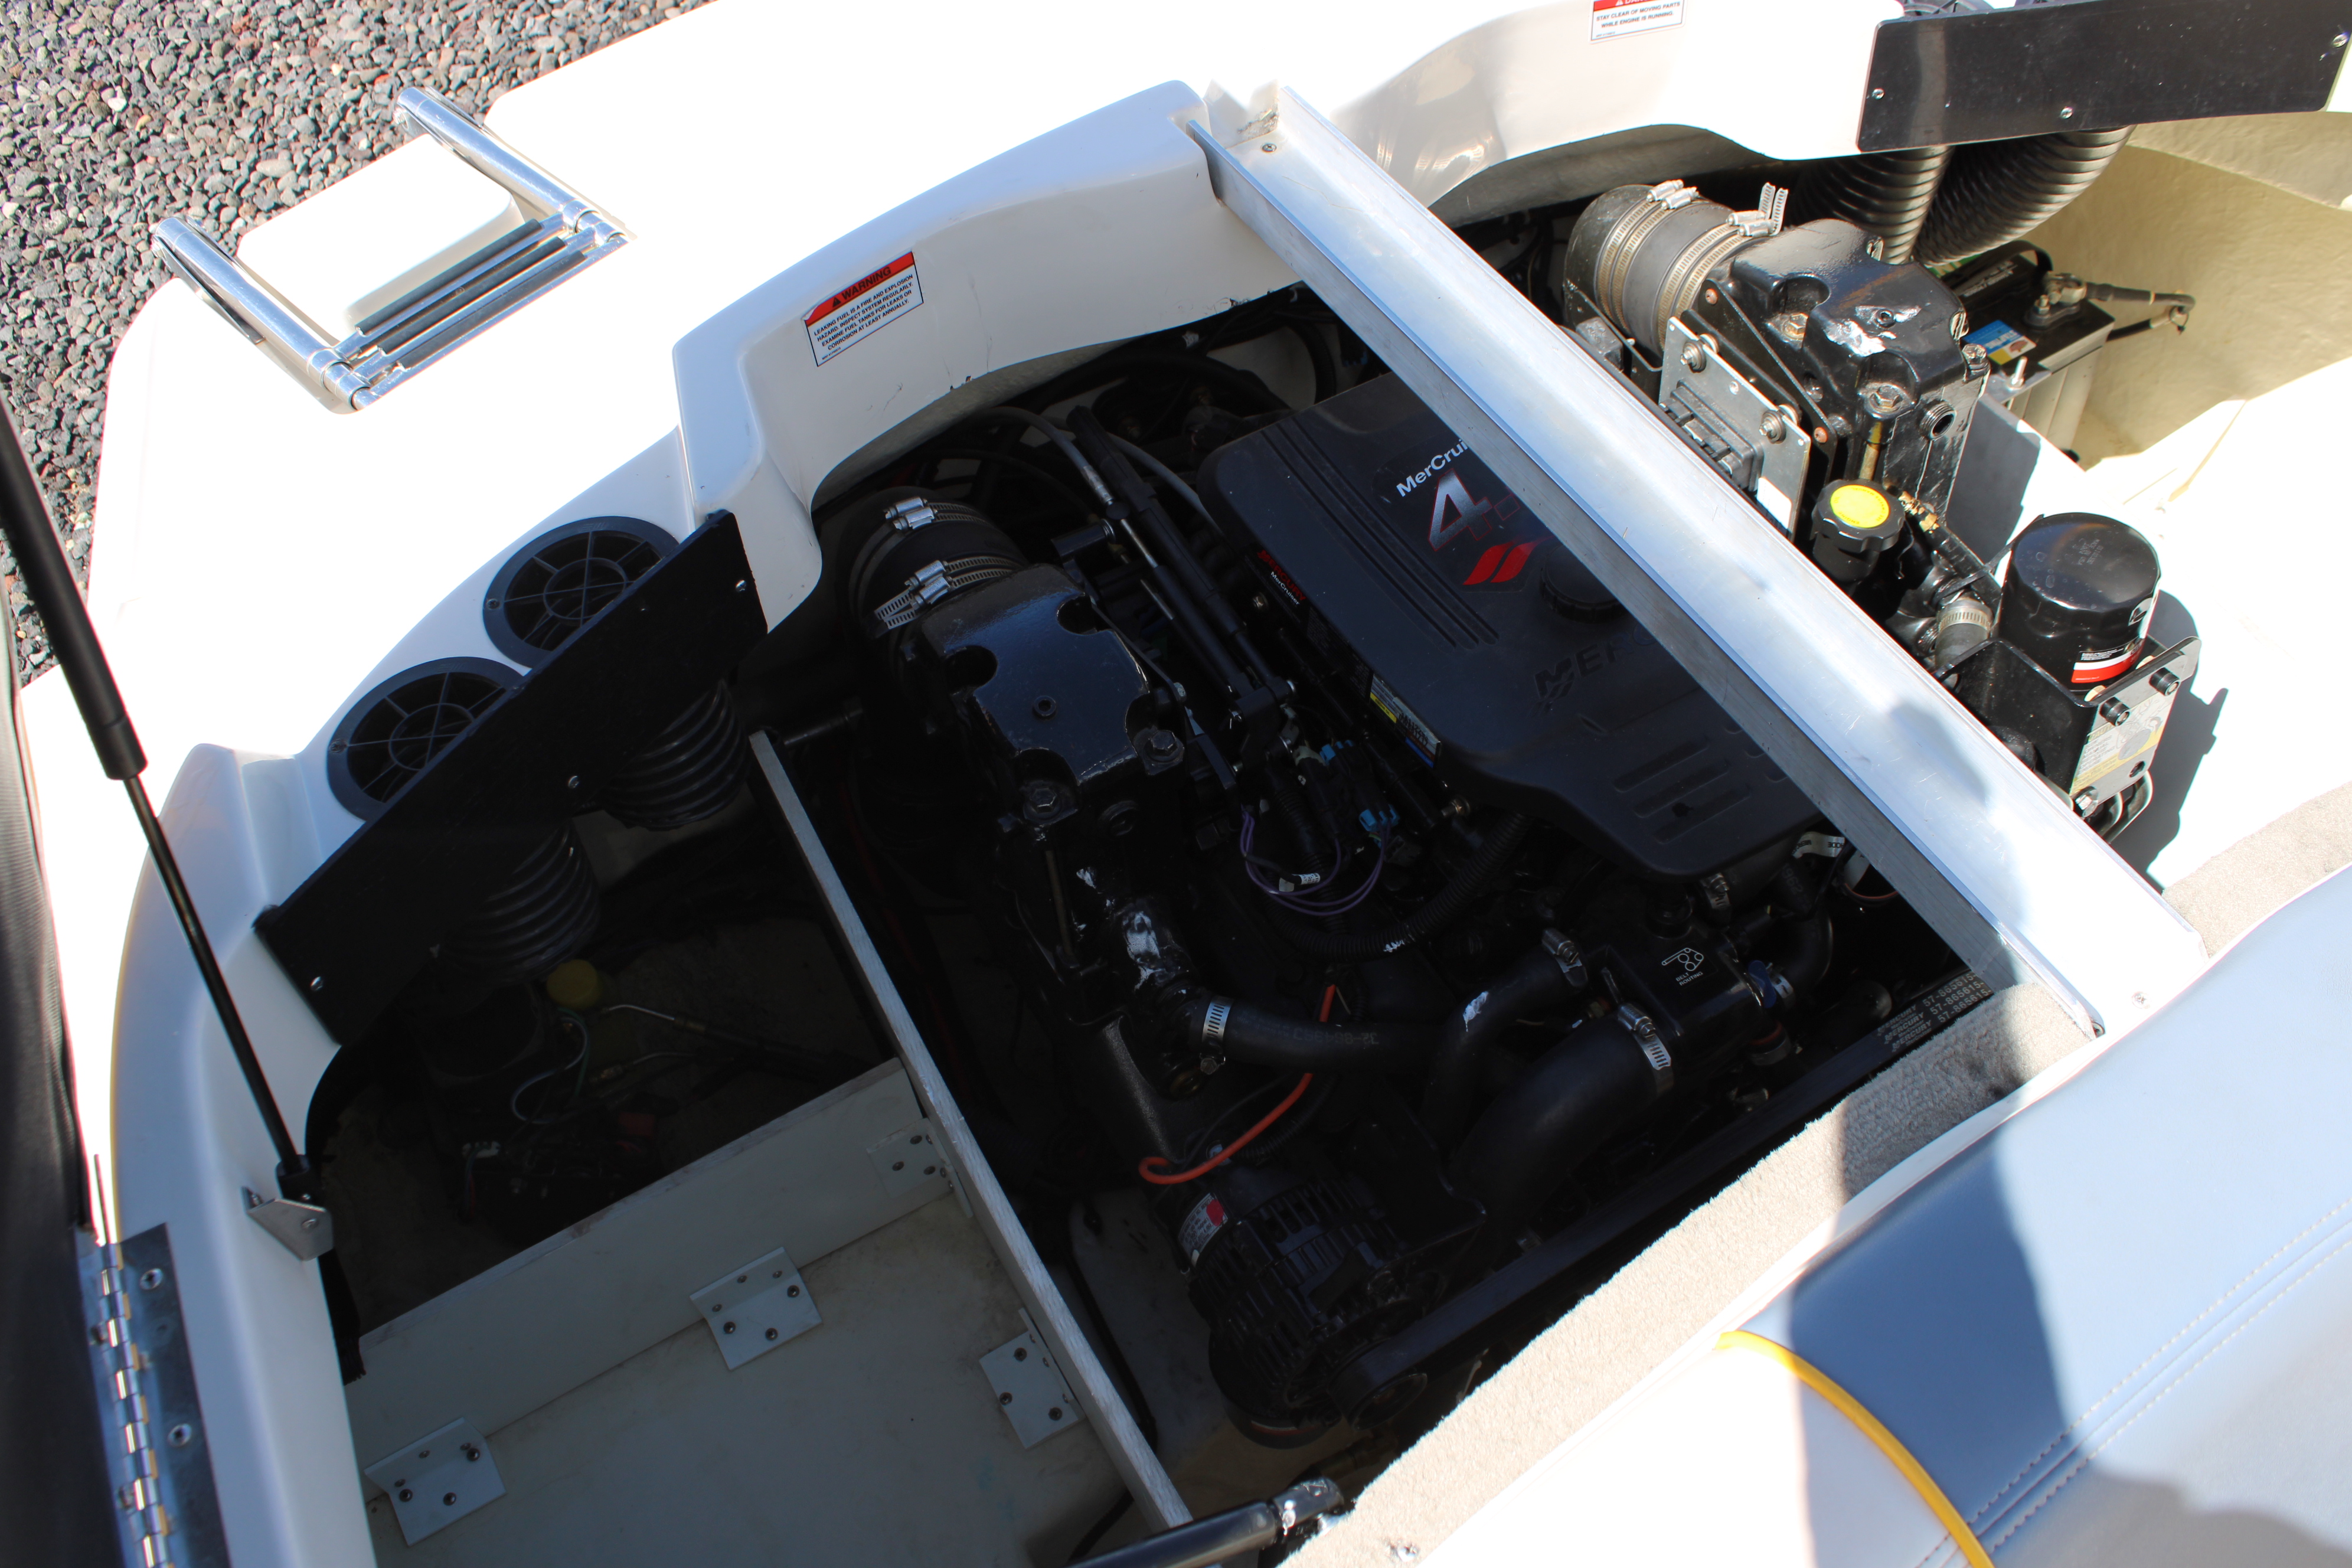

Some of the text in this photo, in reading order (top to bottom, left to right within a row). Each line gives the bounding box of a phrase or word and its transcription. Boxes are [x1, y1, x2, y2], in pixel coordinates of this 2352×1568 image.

[1611, 10, 1629, 18] CLEAR
[814, 319, 836, 336] LEAKING
[837, 312, 850, 323] FUEL
[861, 299, 873, 308] FIRE
[874, 291, 884, 302] AND
[884, 275, 913, 293] EXPLOSION
[842, 267, 891, 300] WARNING
[817, 282, 913, 342] HAZARD. INSPECT SYSTEM REGULARLY.
[822, 331, 844, 347] EXAMINE
[845, 323, 858, 333] FUEL
[859, 313, 875, 326] TANKS
[876, 306, 886, 315] FOR
[887, 296, 903, 308] LEAKS
[828, 331, 858, 350] CORROSION
[865, 316, 882, 328] LEAST
[882, 299, 909, 317] ANNUALLY.
[1396, 439, 1469, 497] MerCrui
[1257, 550, 1306, 601] MERCURY
[1270, 570, 1301, 605] MerCruiser
[1530, 623, 1657, 713] MERC
[1675, 972, 1689, 982] BELT
[1679, 971, 1703, 986] ROUTING
[1877, 1004, 1916, 1036] MERCURY
[1884, 980, 1985, 1044] MERCURY 57-865615-
[1891, 988, 1992, 1053] MERCURY 57-865615-
